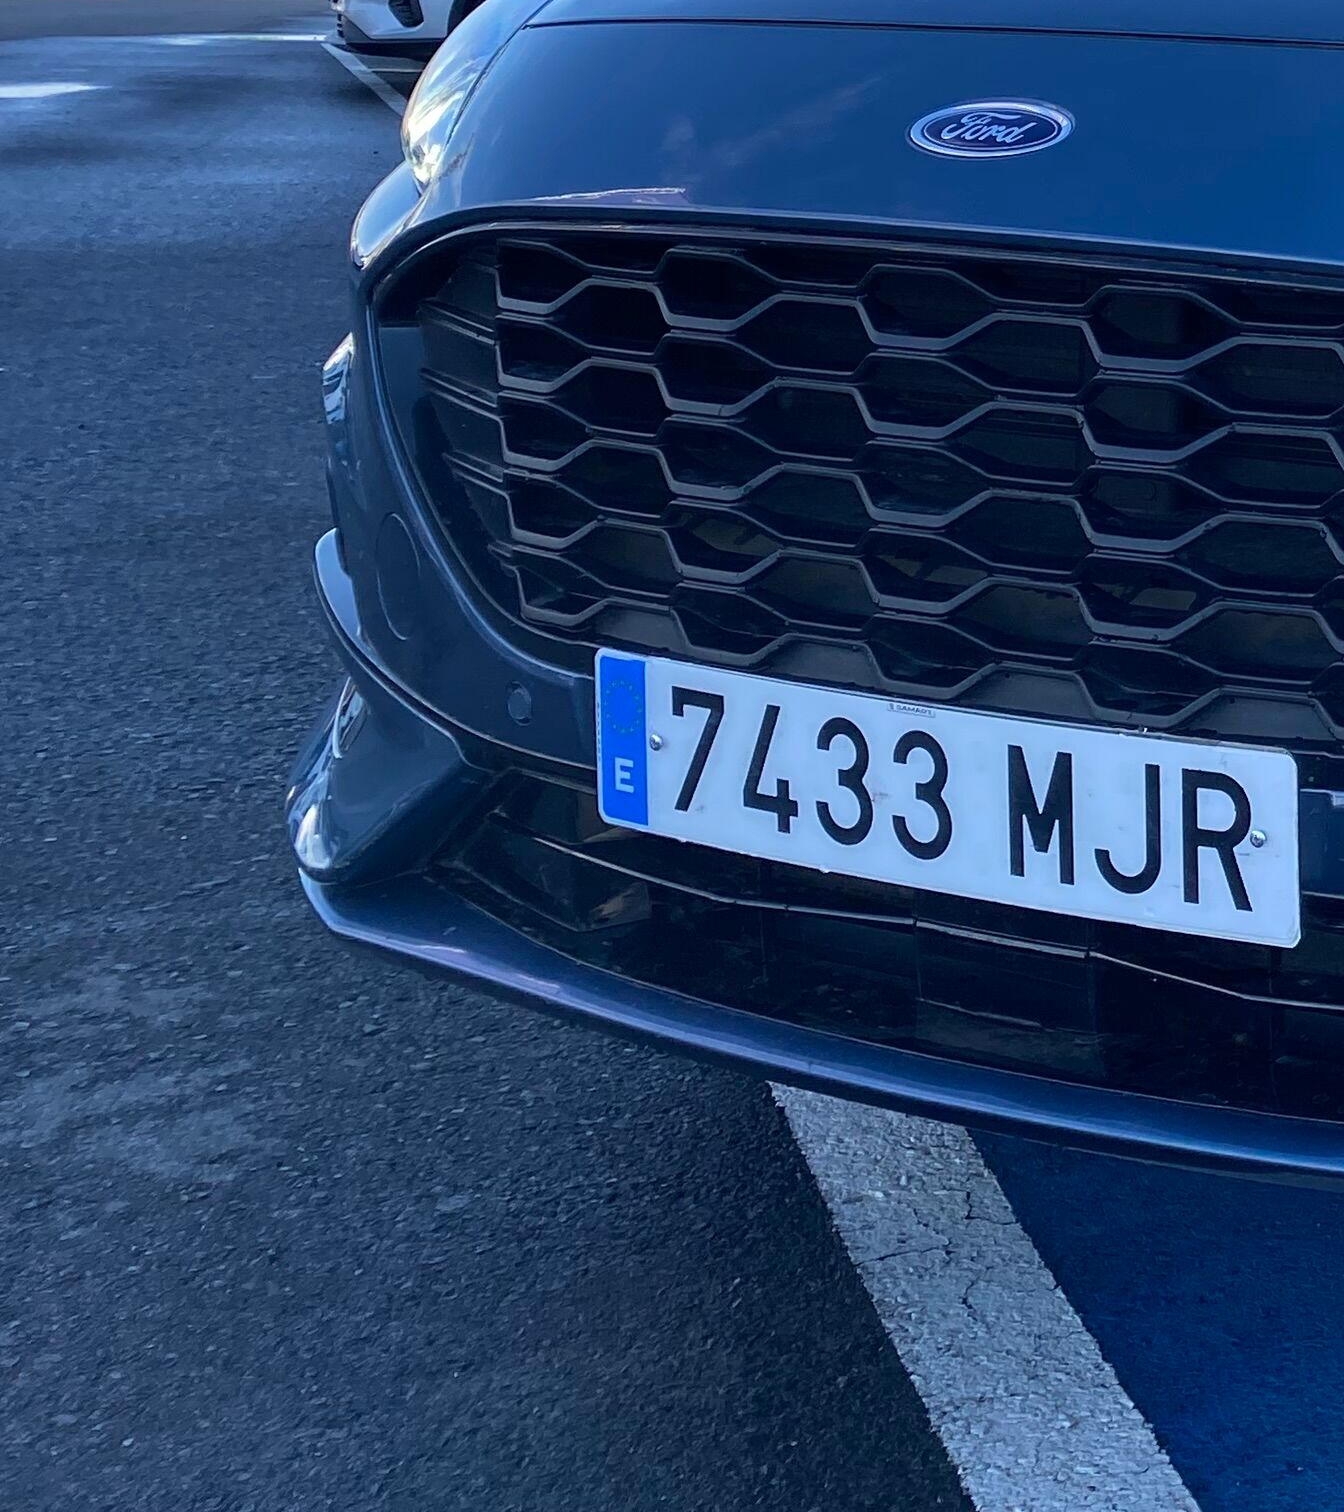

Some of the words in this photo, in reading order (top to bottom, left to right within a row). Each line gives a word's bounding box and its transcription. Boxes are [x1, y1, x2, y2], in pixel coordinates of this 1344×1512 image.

[941, 111, 1038, 144] Ford
[614, 756, 635, 794] E
[671, 685, 953, 861] 7433
[1007, 744, 1254, 913] MJR
